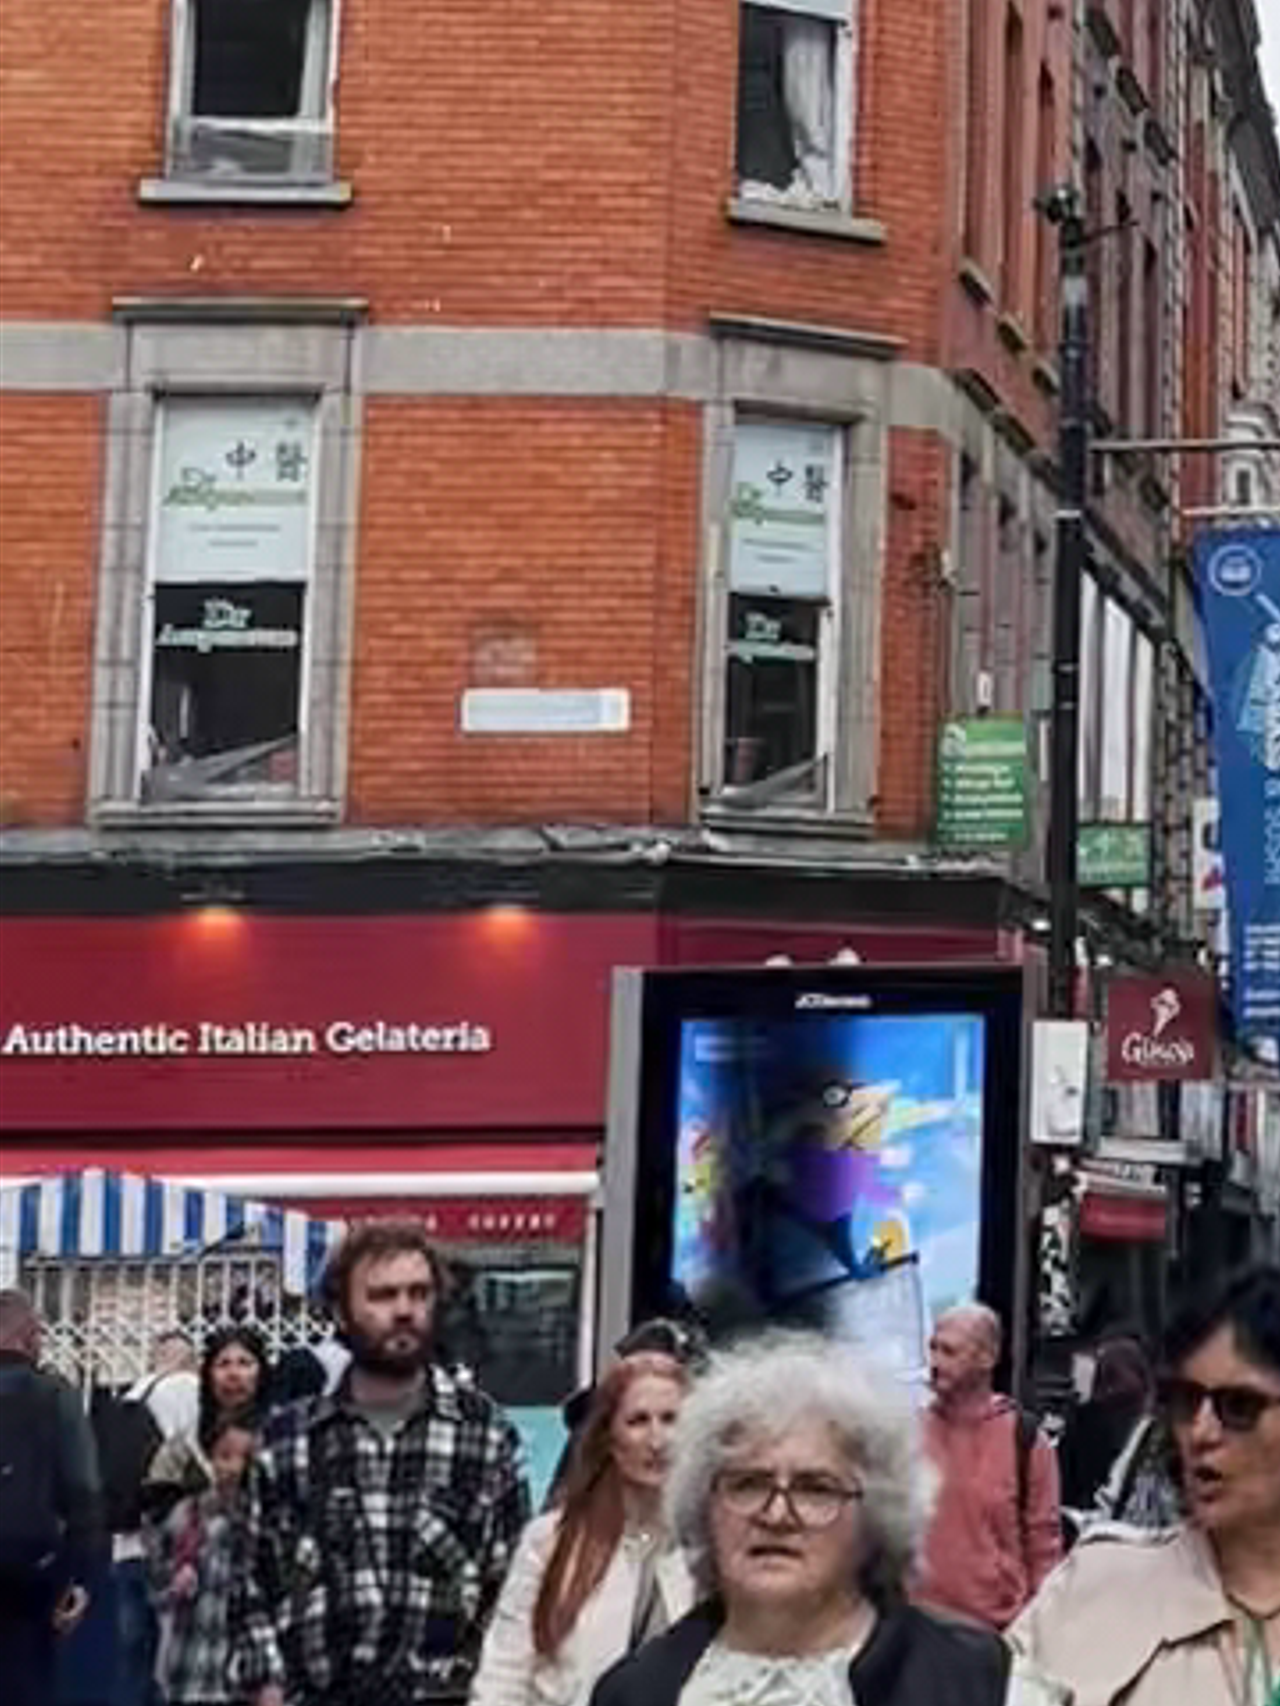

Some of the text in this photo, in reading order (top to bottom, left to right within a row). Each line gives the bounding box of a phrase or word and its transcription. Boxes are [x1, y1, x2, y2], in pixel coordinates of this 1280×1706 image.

[1, 1020, 491, 1056] Authentic Italian Gelateria
